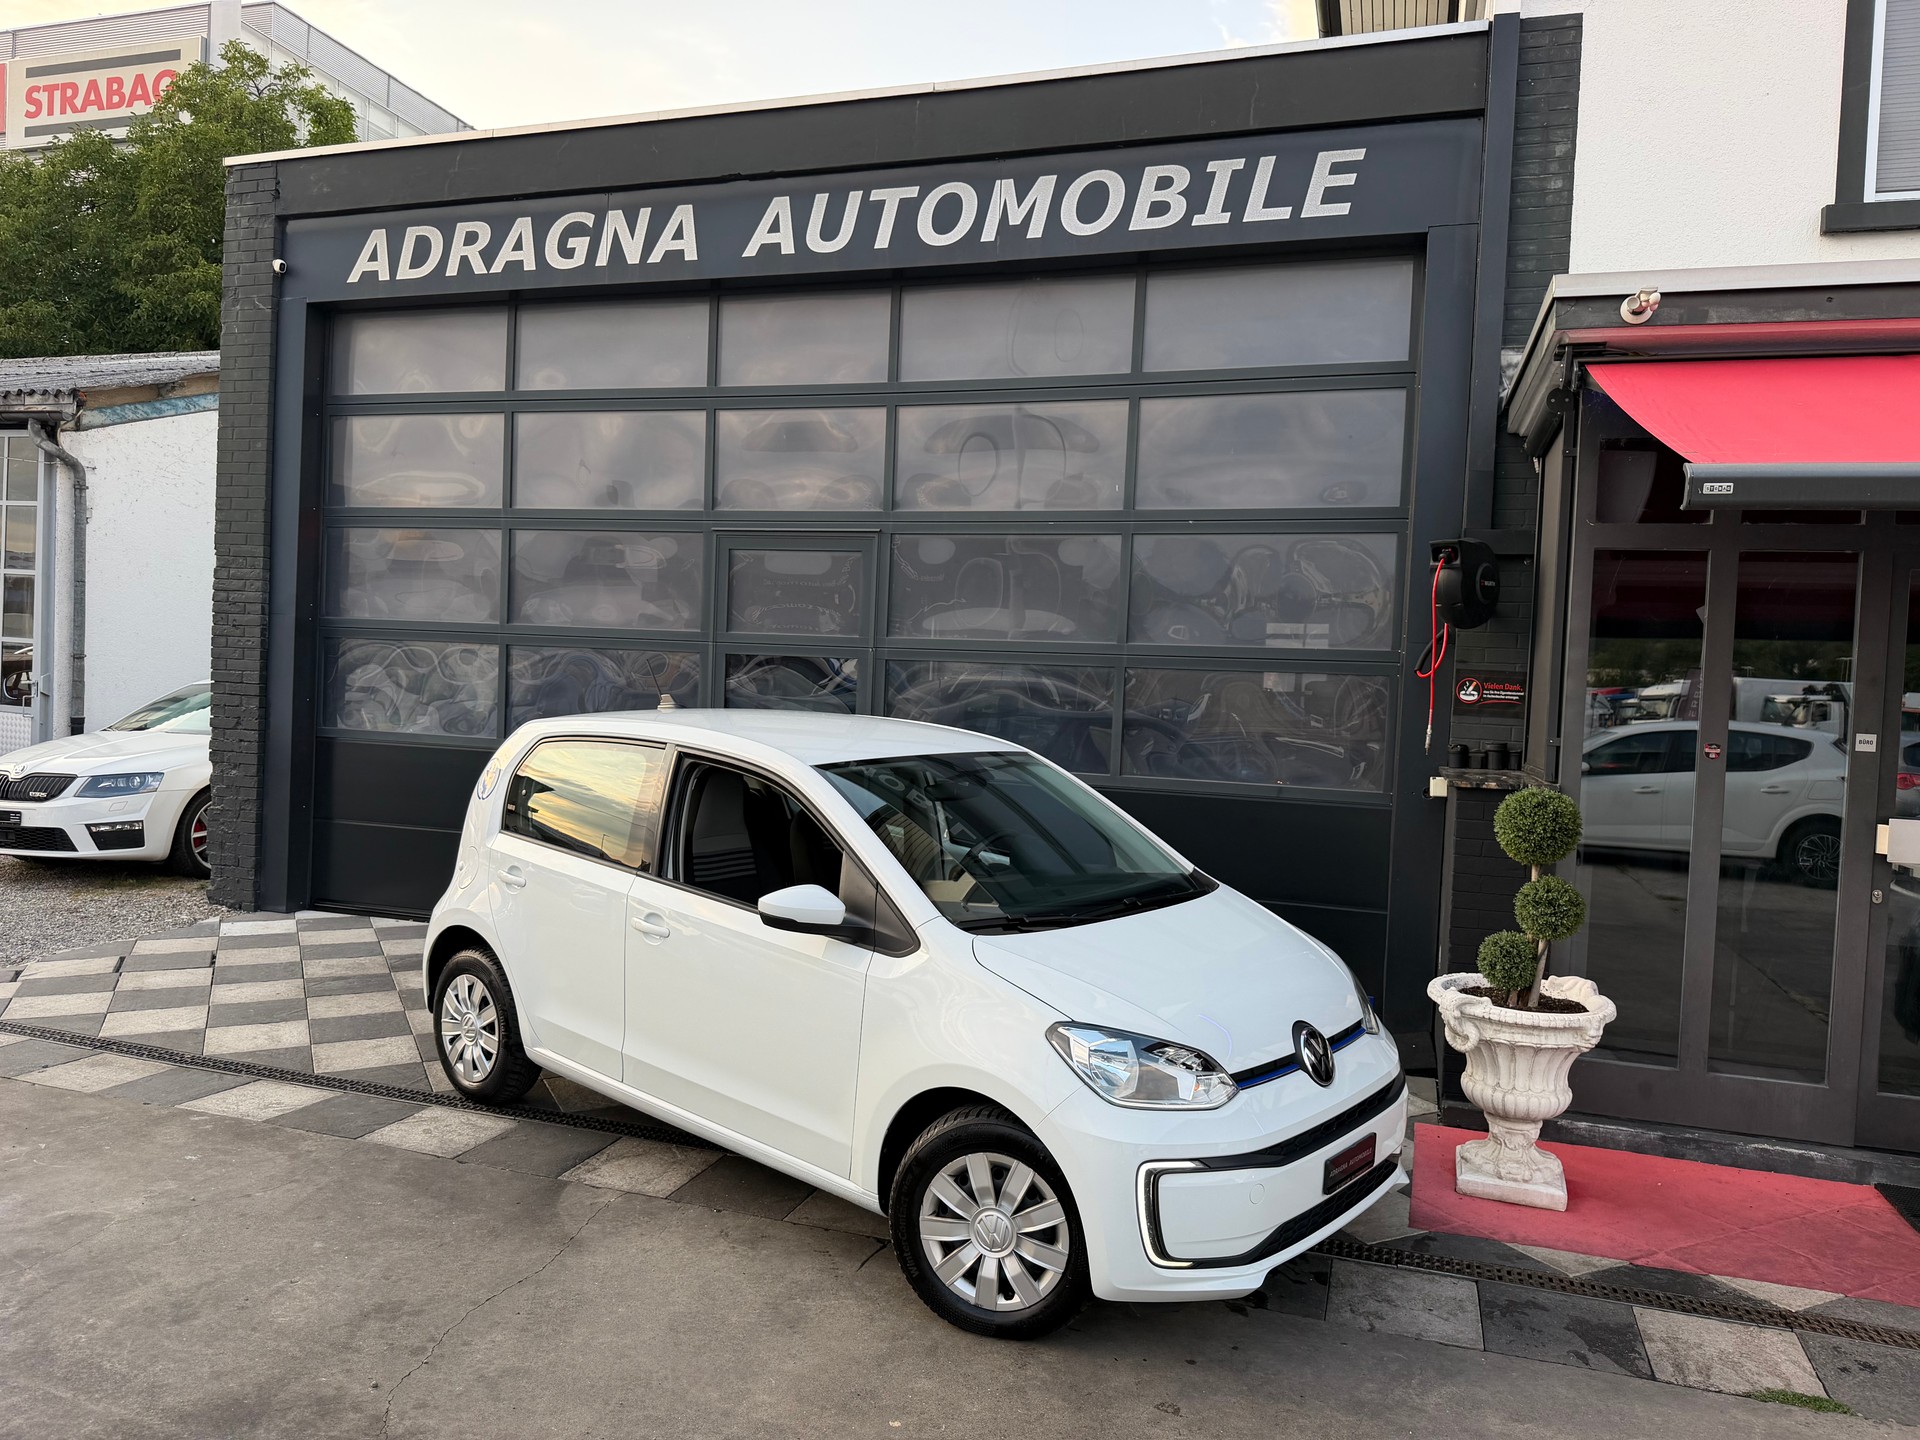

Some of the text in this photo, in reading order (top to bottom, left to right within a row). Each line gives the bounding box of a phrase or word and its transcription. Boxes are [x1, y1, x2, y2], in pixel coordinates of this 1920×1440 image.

[346, 148, 1367, 283] ADRAGNA AUTOMOBILE
[1483, 682, 1504, 690] Vielen
[1858, 738, 1874, 746] BÜRO
